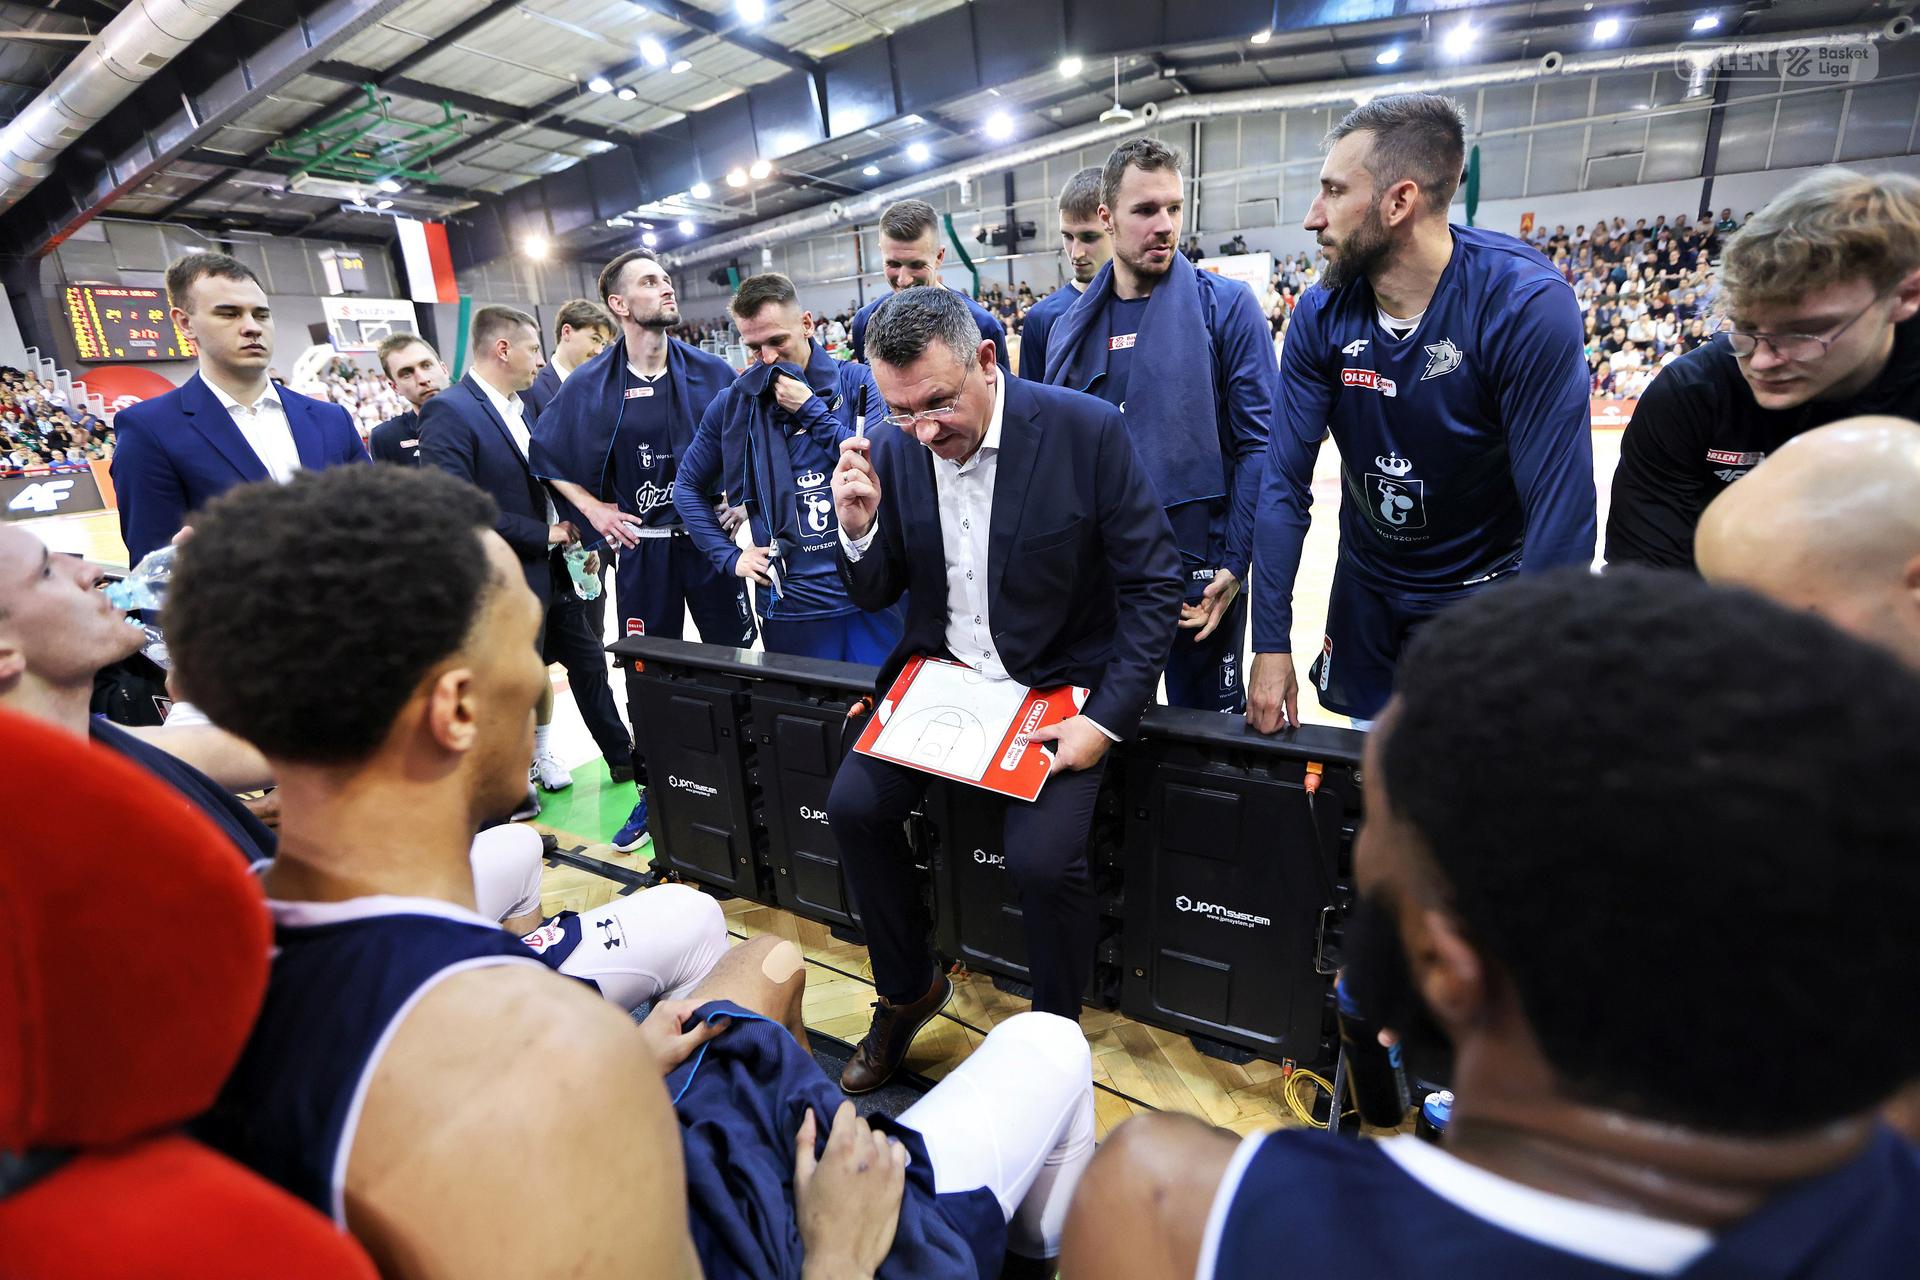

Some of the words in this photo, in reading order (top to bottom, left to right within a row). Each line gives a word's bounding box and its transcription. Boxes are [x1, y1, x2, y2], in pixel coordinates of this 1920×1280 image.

[1341, 339, 1370, 357] 4F
[1344, 372, 1371, 384] OLEN
[8, 479, 76, 512] 4F
[1022, 703, 1044, 732] ORLEN
